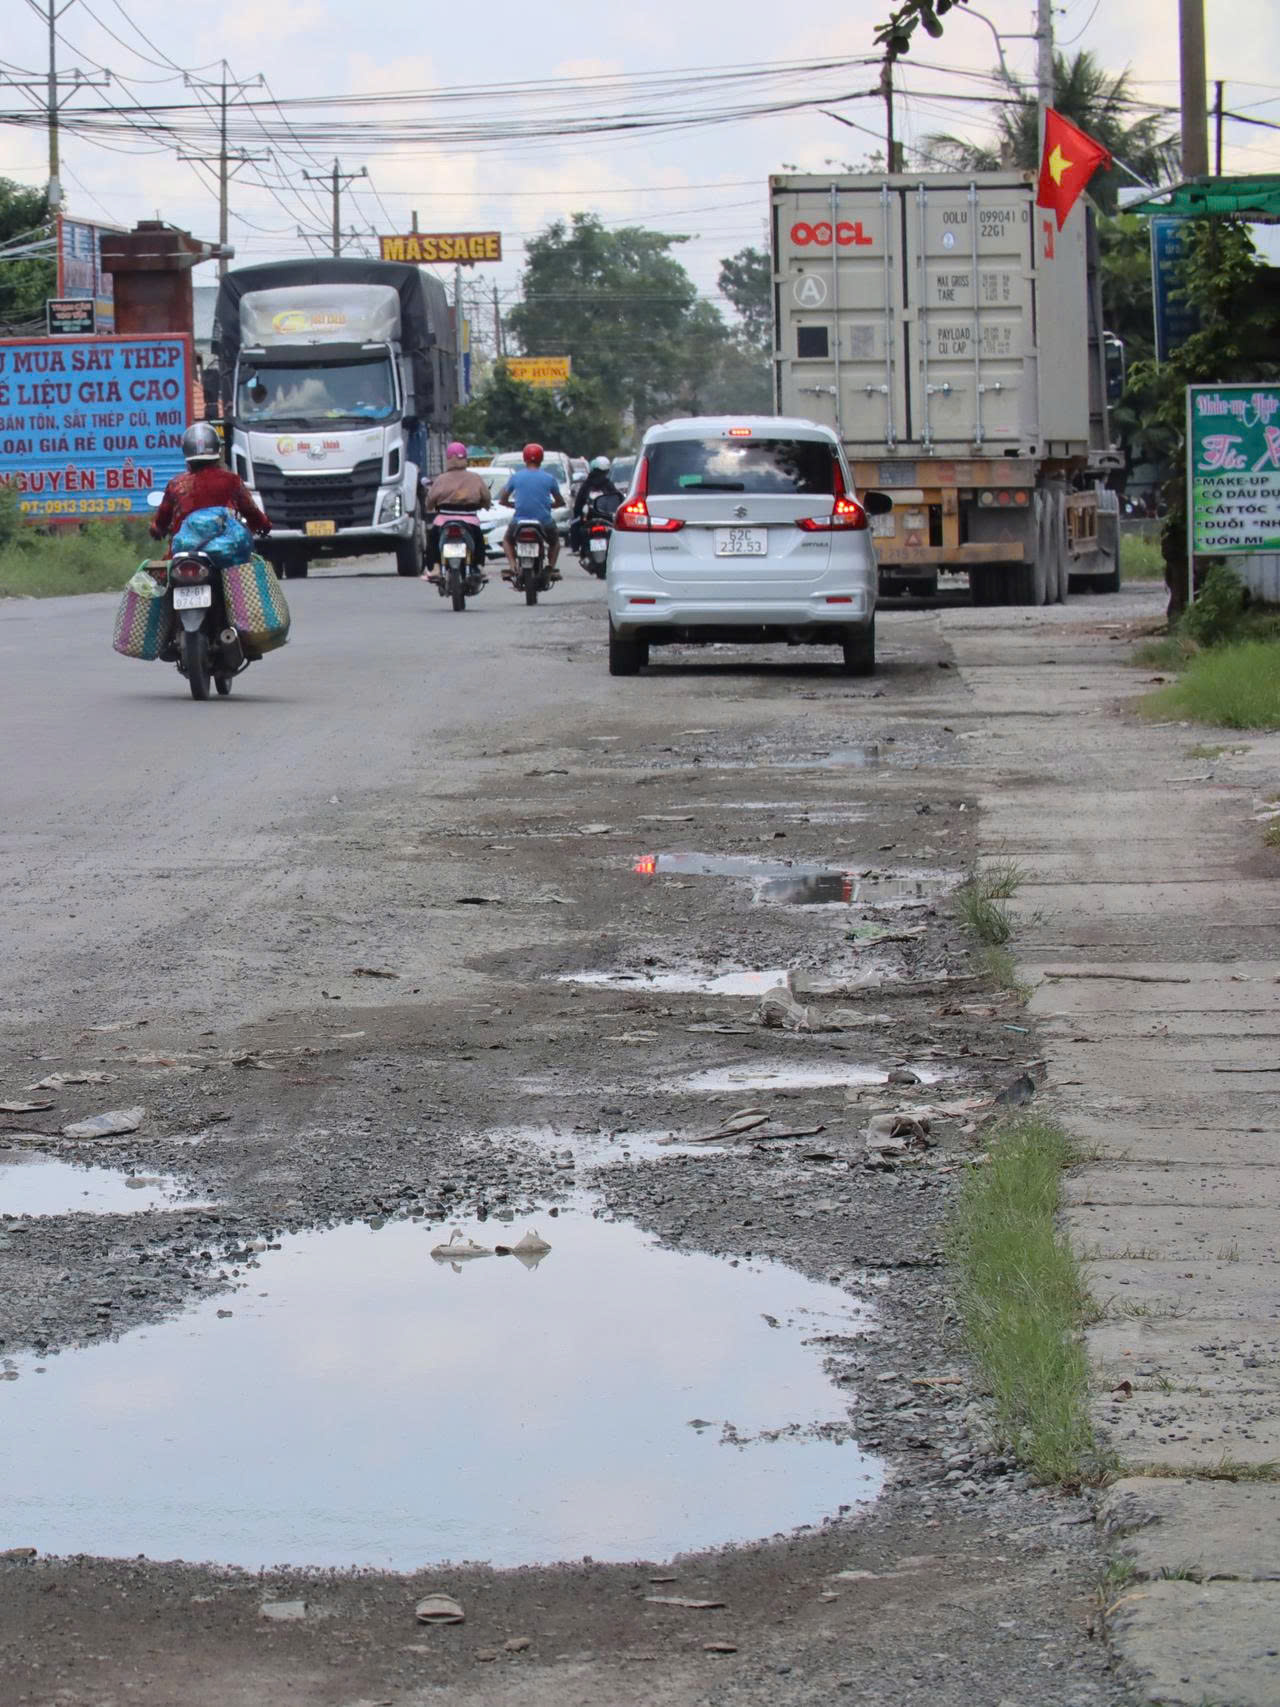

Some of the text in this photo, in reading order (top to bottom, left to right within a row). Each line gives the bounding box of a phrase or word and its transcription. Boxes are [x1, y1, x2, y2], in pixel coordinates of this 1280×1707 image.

[790, 221, 873, 246] OOCL
[383, 237, 499, 261] MASSAGE
[938, 289, 955, 300] TARE
[938, 328, 970, 340] PAYLOAD
[13, 351, 66, 373] MUA
[121, 342, 180, 369] THÉP
[17, 378, 72, 409] LIỆU
[78, 376, 122, 403] GIÁ
[129, 379, 180, 401] CAO
[39, 433, 69, 452] GIÁ
[103, 435, 139, 452] QUA
[145, 430, 184, 449] CÂN
[729, 529, 752, 541] 62C
